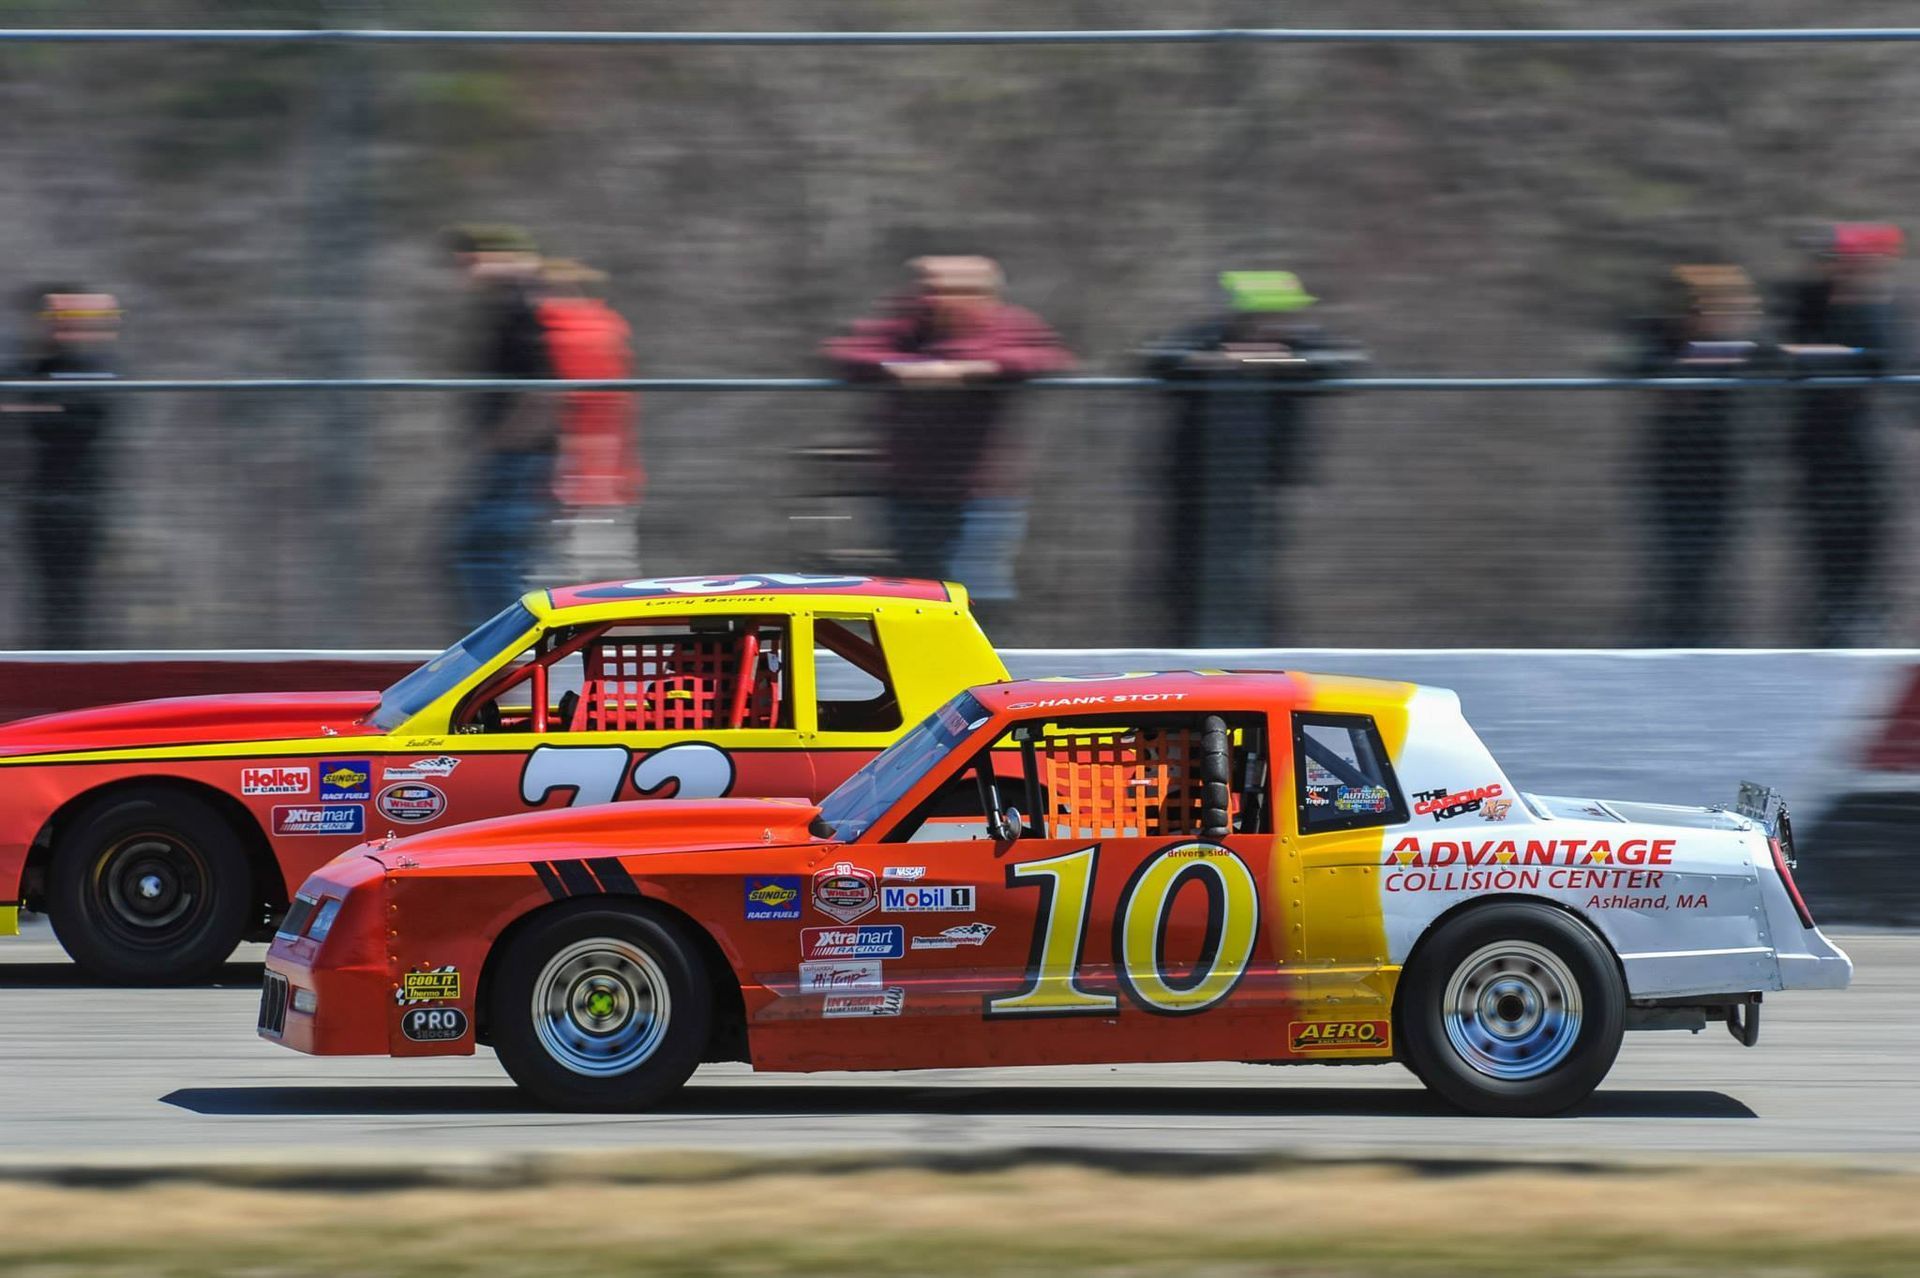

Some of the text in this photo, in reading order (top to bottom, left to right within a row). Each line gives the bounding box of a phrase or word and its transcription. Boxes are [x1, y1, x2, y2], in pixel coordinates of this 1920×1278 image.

[1038, 696, 1106, 708] HANK
[1112, 693, 1189, 703] STOTT
[244, 769, 308, 791] Holley
[324, 774, 365, 782] SUNOCO
[1305, 798, 1330, 806] Troops
[1412, 788, 1448, 802] THE
[1414, 784, 1503, 815] CARDIAC
[390, 800, 434, 808] WHELEN
[284, 808, 354, 823] Xtramart
[301, 823, 348, 831] RACING
[1167, 849, 1231, 858] drivers side
[1384, 837, 1677, 868] ADVANTAGE
[836, 864, 852, 876] 30
[894, 868, 924, 877] NASCAR
[1385, 869, 1665, 892] COLLISION CENTER
[750, 890, 796, 900] SUNOCO
[826, 889, 865, 897] WHELEN
[886, 888, 945, 907] Mobil
[1586, 894, 1709, 910] Ashland, MA
[747, 911, 771, 919] RACE
[815, 930, 893, 947] Xtramart
[984, 841, 1262, 1022] 10
[837, 946, 885, 954] RACING
[408, 975, 454, 985] COOL IT
[812, 967, 872, 989] Hi-Temp
[409, 986, 457, 997] Thermo Tec
[414, 1011, 456, 1029] PRO
[1300, 1023, 1375, 1040] AERO
